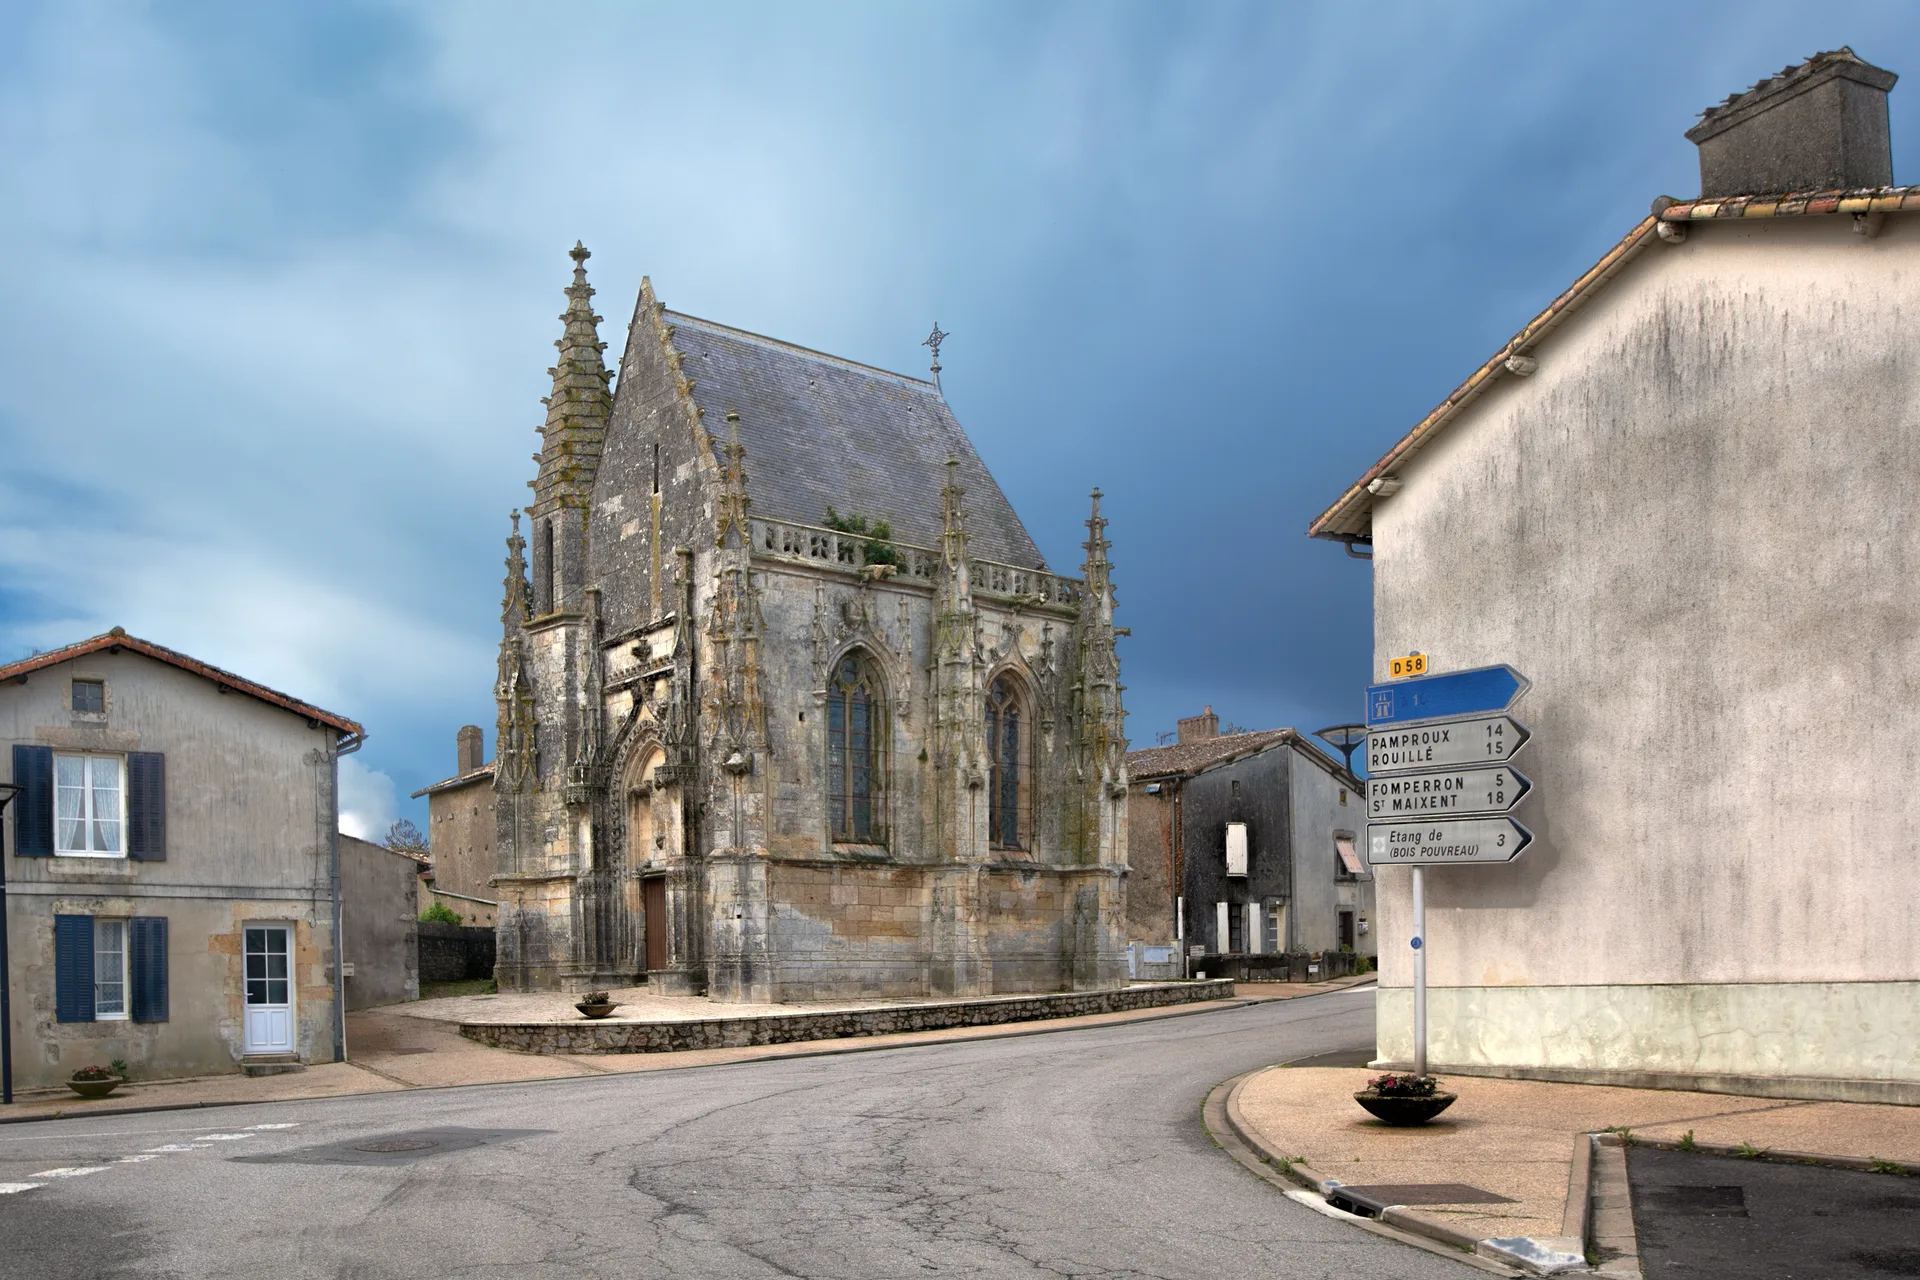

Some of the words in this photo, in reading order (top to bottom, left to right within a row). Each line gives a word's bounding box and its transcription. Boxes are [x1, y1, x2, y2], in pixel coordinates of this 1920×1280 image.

[1394, 662, 1401, 674] D
[1406, 658, 1422, 672] 58
[1372, 730, 1449, 750] PAMPROUX
[1486, 724, 1503, 737] 14
[1372, 746, 1432, 766] ROUILLÉ
[1486, 742, 1503, 755] 15
[1373, 777, 1463, 796] FOMPERRON
[1496, 774, 1503, 786] 5
[1393, 795, 1457, 810] MAIXENT
[1487, 791, 1504, 804] 18
[1390, 830, 1421, 845] Etang
[1429, 829, 1442, 841] de
[1497, 834, 1505, 846] 3
[1390, 847, 1415, 858] (BOIS
[1420, 844, 1479, 857] POUVREAU)
